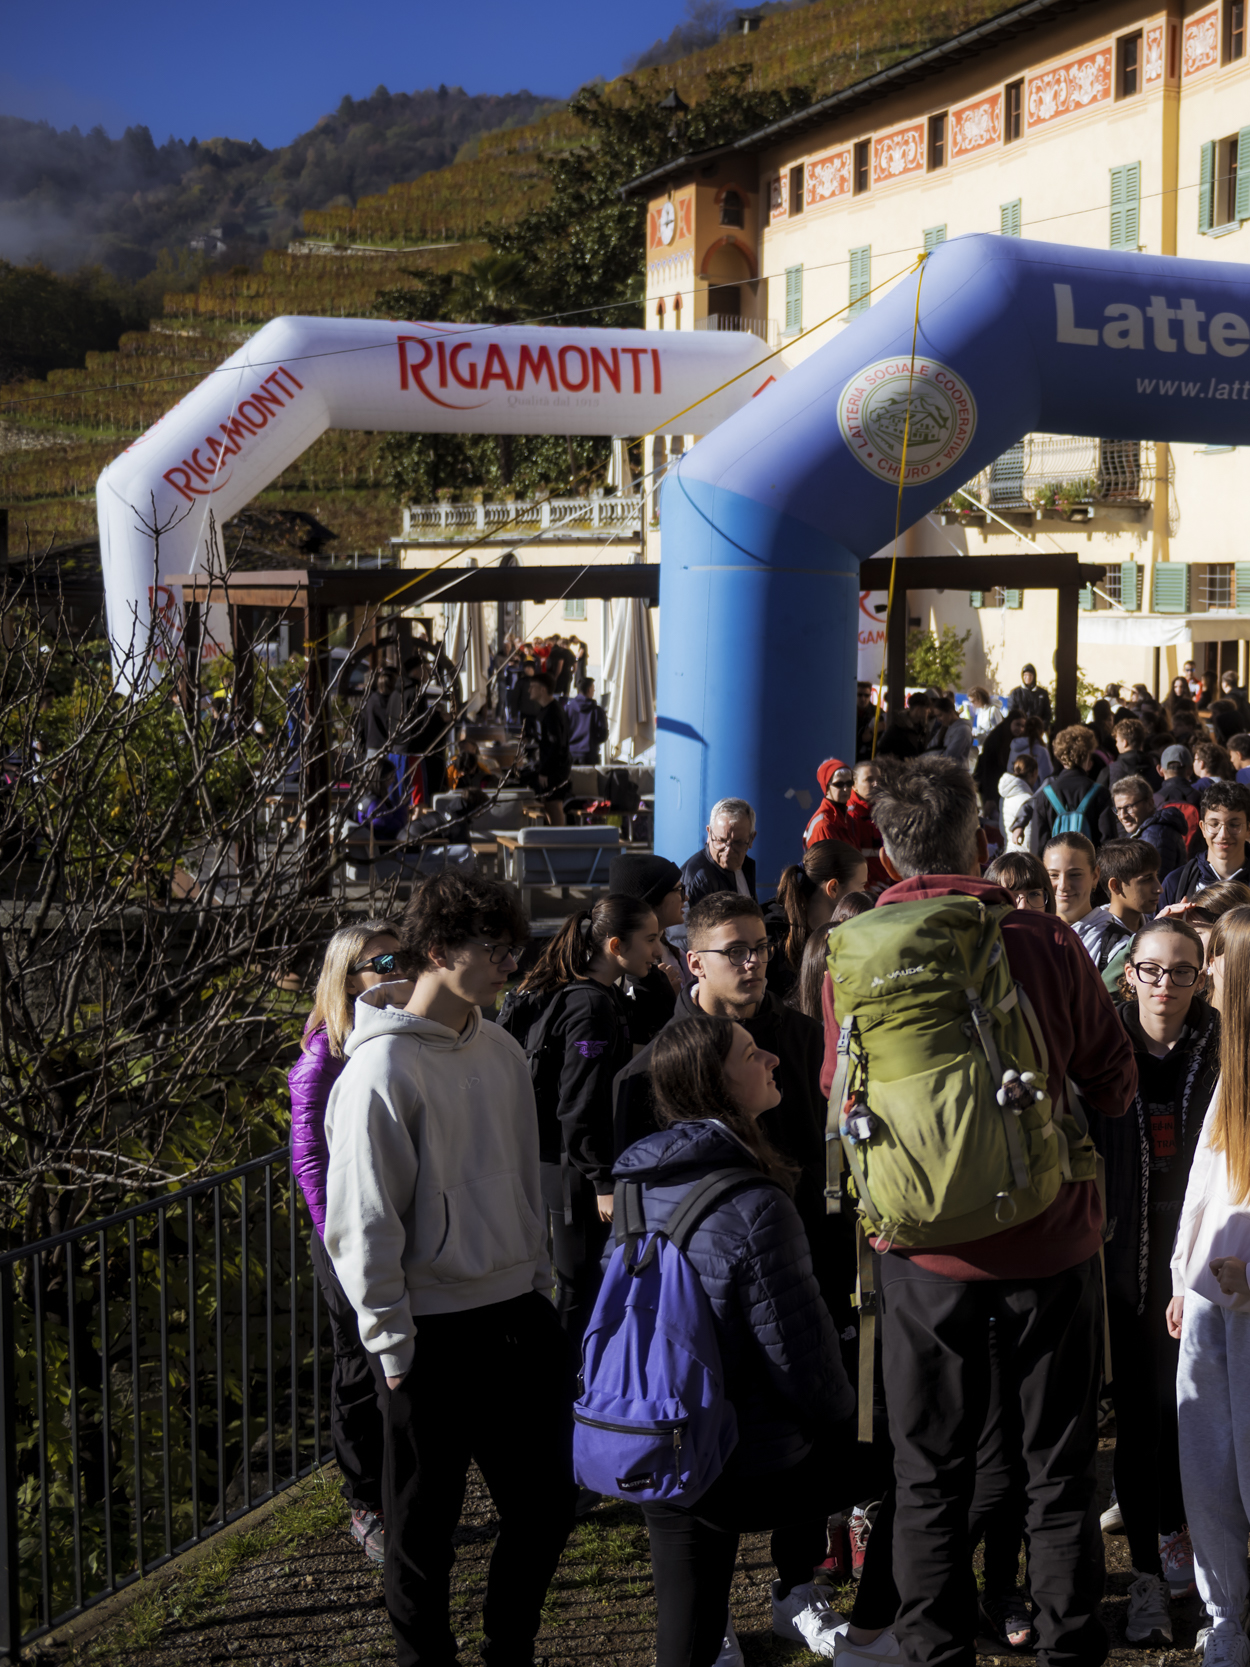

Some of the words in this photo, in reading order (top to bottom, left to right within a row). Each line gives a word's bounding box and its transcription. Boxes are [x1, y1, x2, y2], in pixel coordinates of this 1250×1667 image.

[397, 335, 662, 410] RIGAMONTI
[162, 365, 304, 502] RIGAMONTI
[846, 386, 868, 450] LATTERIA
[864, 363, 930, 386] SOCIALE
[935, 371, 970, 460] COOPERATIVA
[877, 458, 931, 479] CHIURO
[886, 965, 925, 980] VAUDE
